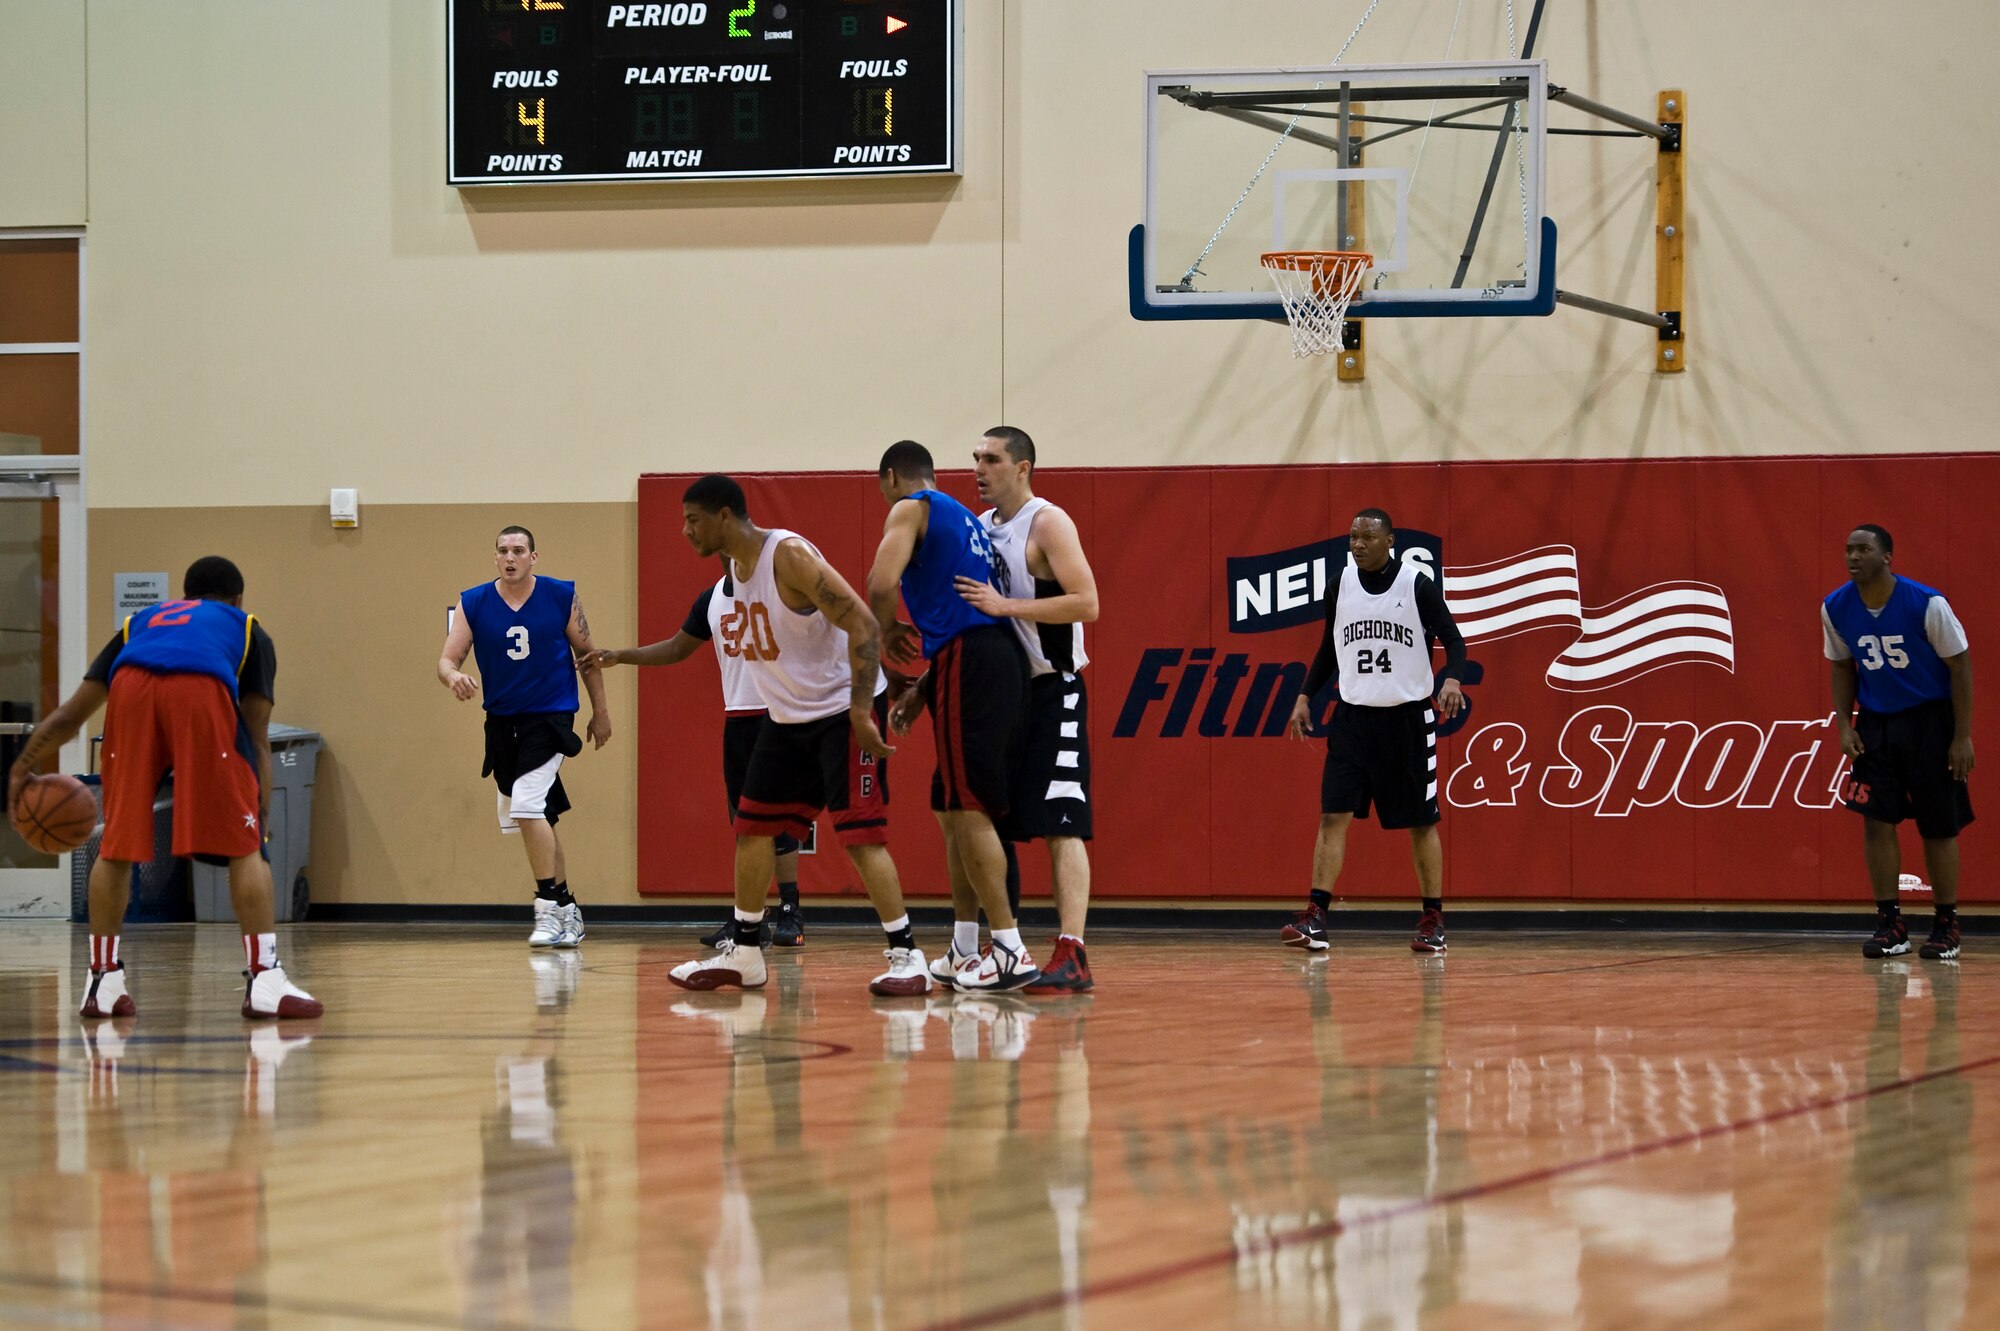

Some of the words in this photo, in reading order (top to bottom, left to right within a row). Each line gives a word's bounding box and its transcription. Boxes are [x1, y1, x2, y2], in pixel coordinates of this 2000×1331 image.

[607, 3, 708, 28] PERIOD
[729, 0, 755, 37] 2
[492, 69, 559, 88] FOULS
[624, 64, 772, 84] PLAYER-FOUL
[840, 59, 908, 78] FOULS
[518, 97, 545, 146] 4
[884, 88, 893, 136] 1
[487, 153, 563, 172] POINTS
[626, 149, 703, 168] MATCH
[833, 144, 911, 164] POINTS
[127, 581, 150, 589] COURT
[1235, 546, 1434, 622] NELS
[147, 599, 203, 629] 2
[506, 625, 530, 660] 3
[734, 600, 780, 661] 20
[1343, 619, 1413, 648] BIGHORNS
[1357, 648, 1392, 674] 24
[1857, 635, 1910, 670] 35
[1446, 722, 1532, 808] &
[1539, 704, 1859, 817] Sport
